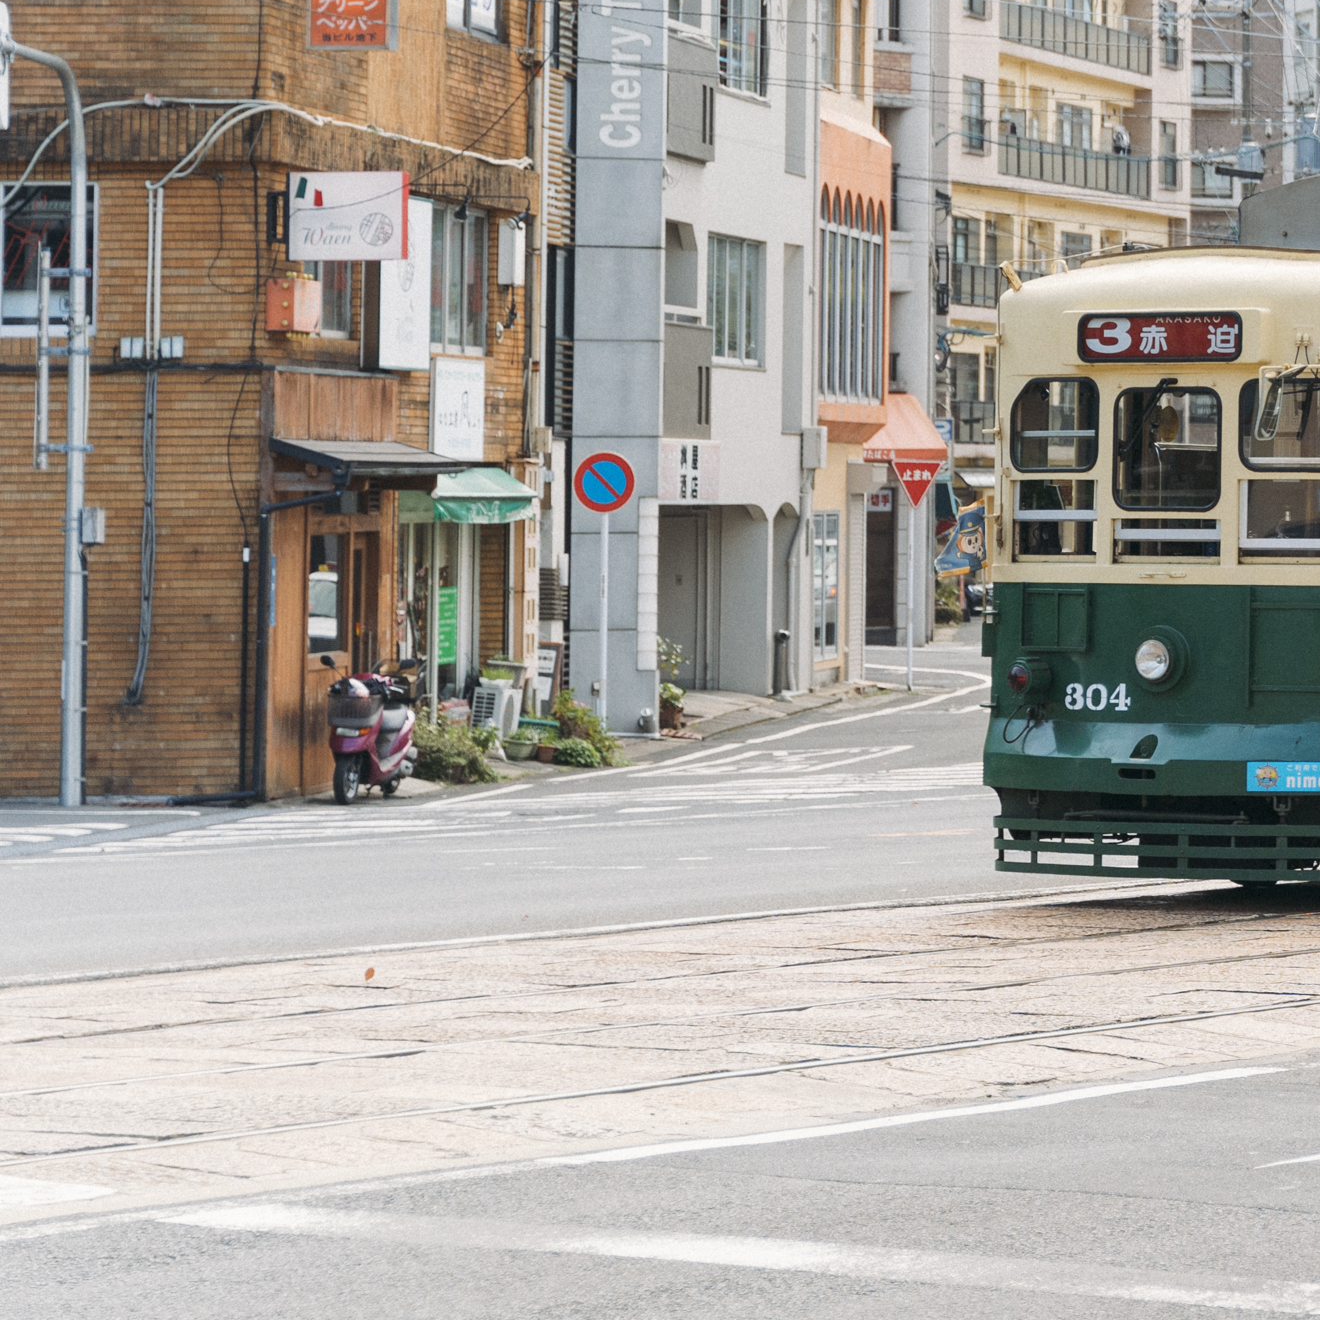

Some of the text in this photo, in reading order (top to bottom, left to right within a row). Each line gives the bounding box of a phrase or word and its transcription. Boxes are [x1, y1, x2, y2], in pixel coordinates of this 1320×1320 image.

[317, 17, 383, 30] ペッパー
[600, 25, 651, 148] Cherry
[301, 227, 351, 245] Waen
[1086, 318, 1235, 354] 3 赤迫
[902, 469, 931, 481] 止まれ
[1065, 683, 1131, 711] 304
